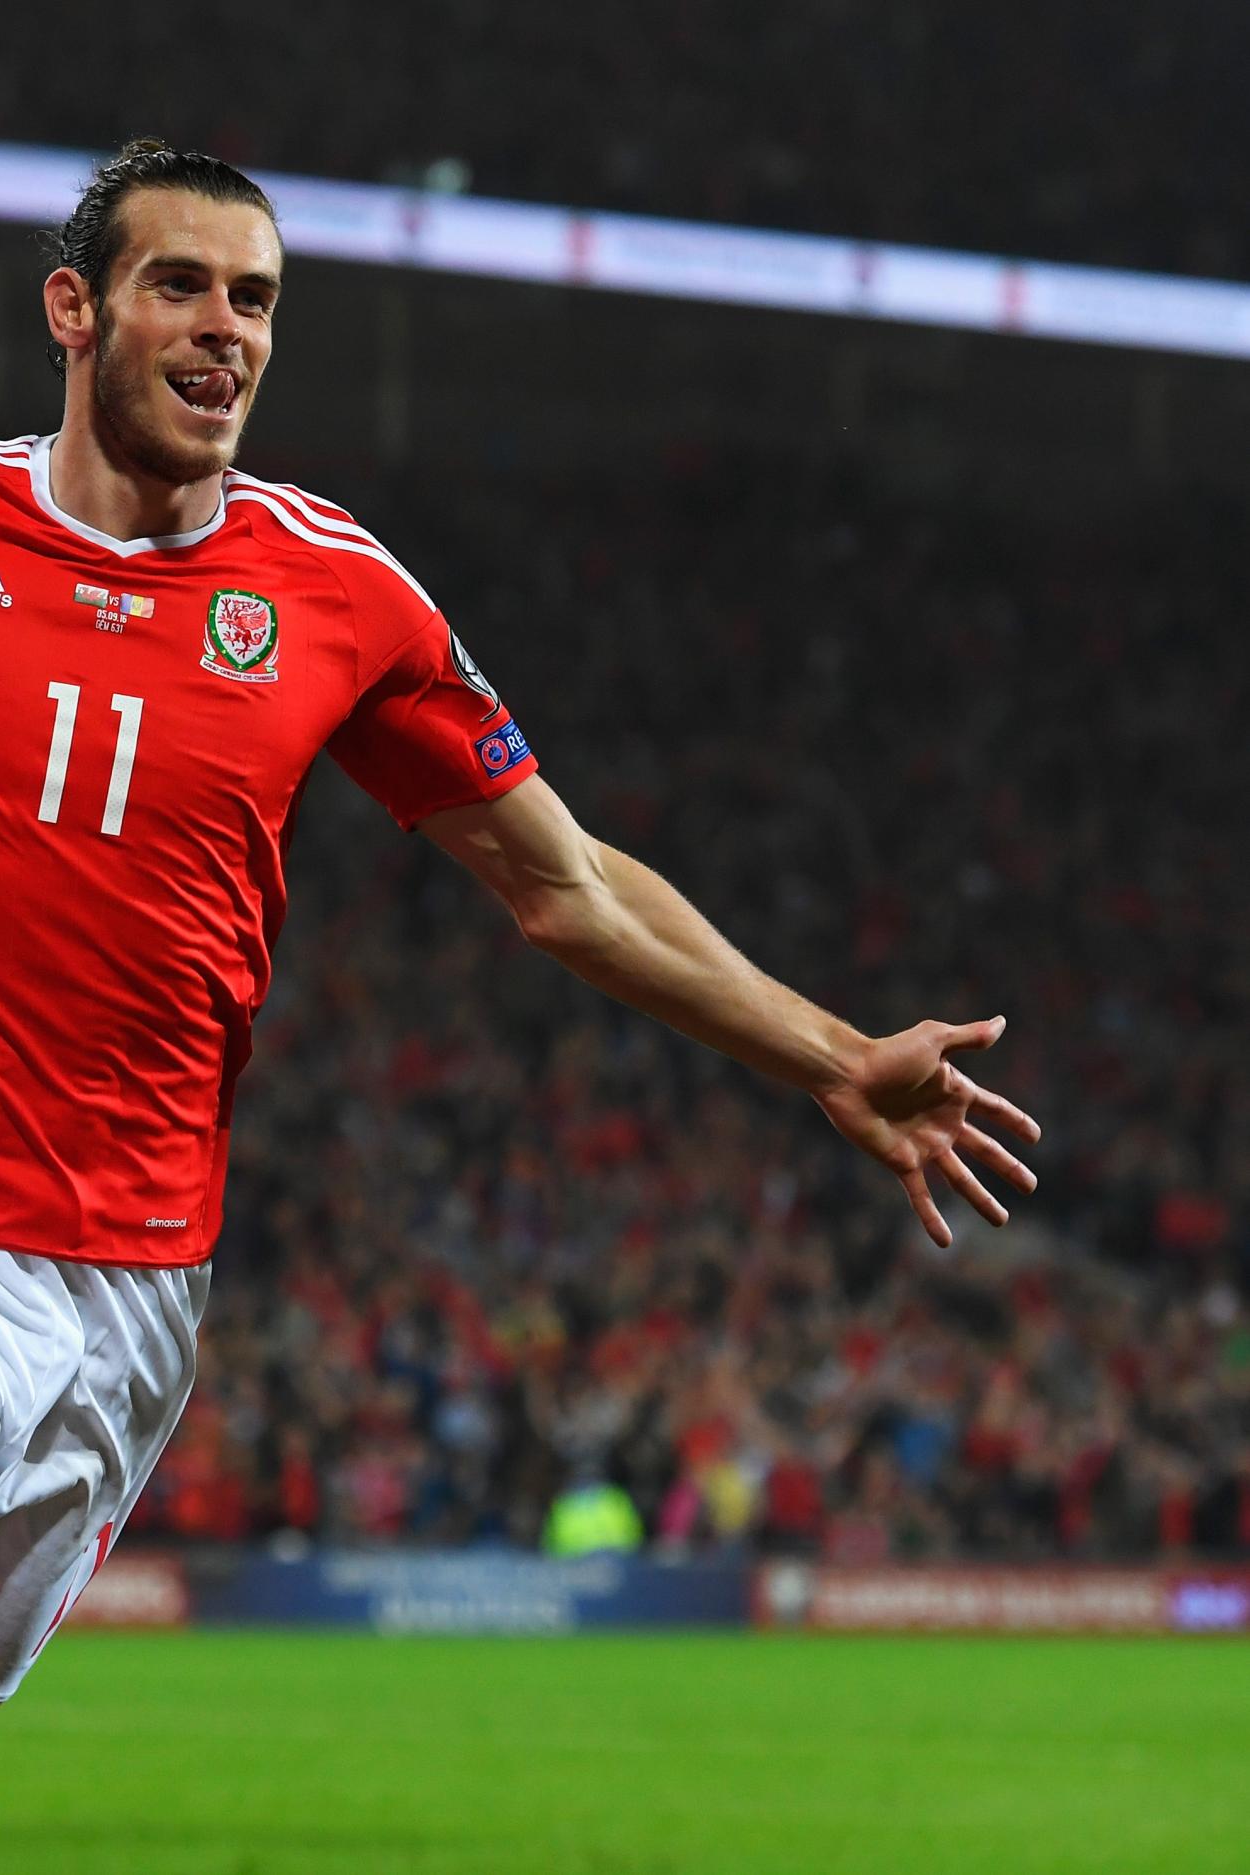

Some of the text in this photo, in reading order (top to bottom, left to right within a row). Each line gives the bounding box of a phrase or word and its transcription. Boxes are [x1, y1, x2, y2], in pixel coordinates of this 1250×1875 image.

[109, 595, 120, 606] VS
[96, 609, 128, 624] 05.09.16
[110, 623, 124, 634] 631
[37, 681, 144, 836] 11
[145, 1216, 187, 1228] climacool
